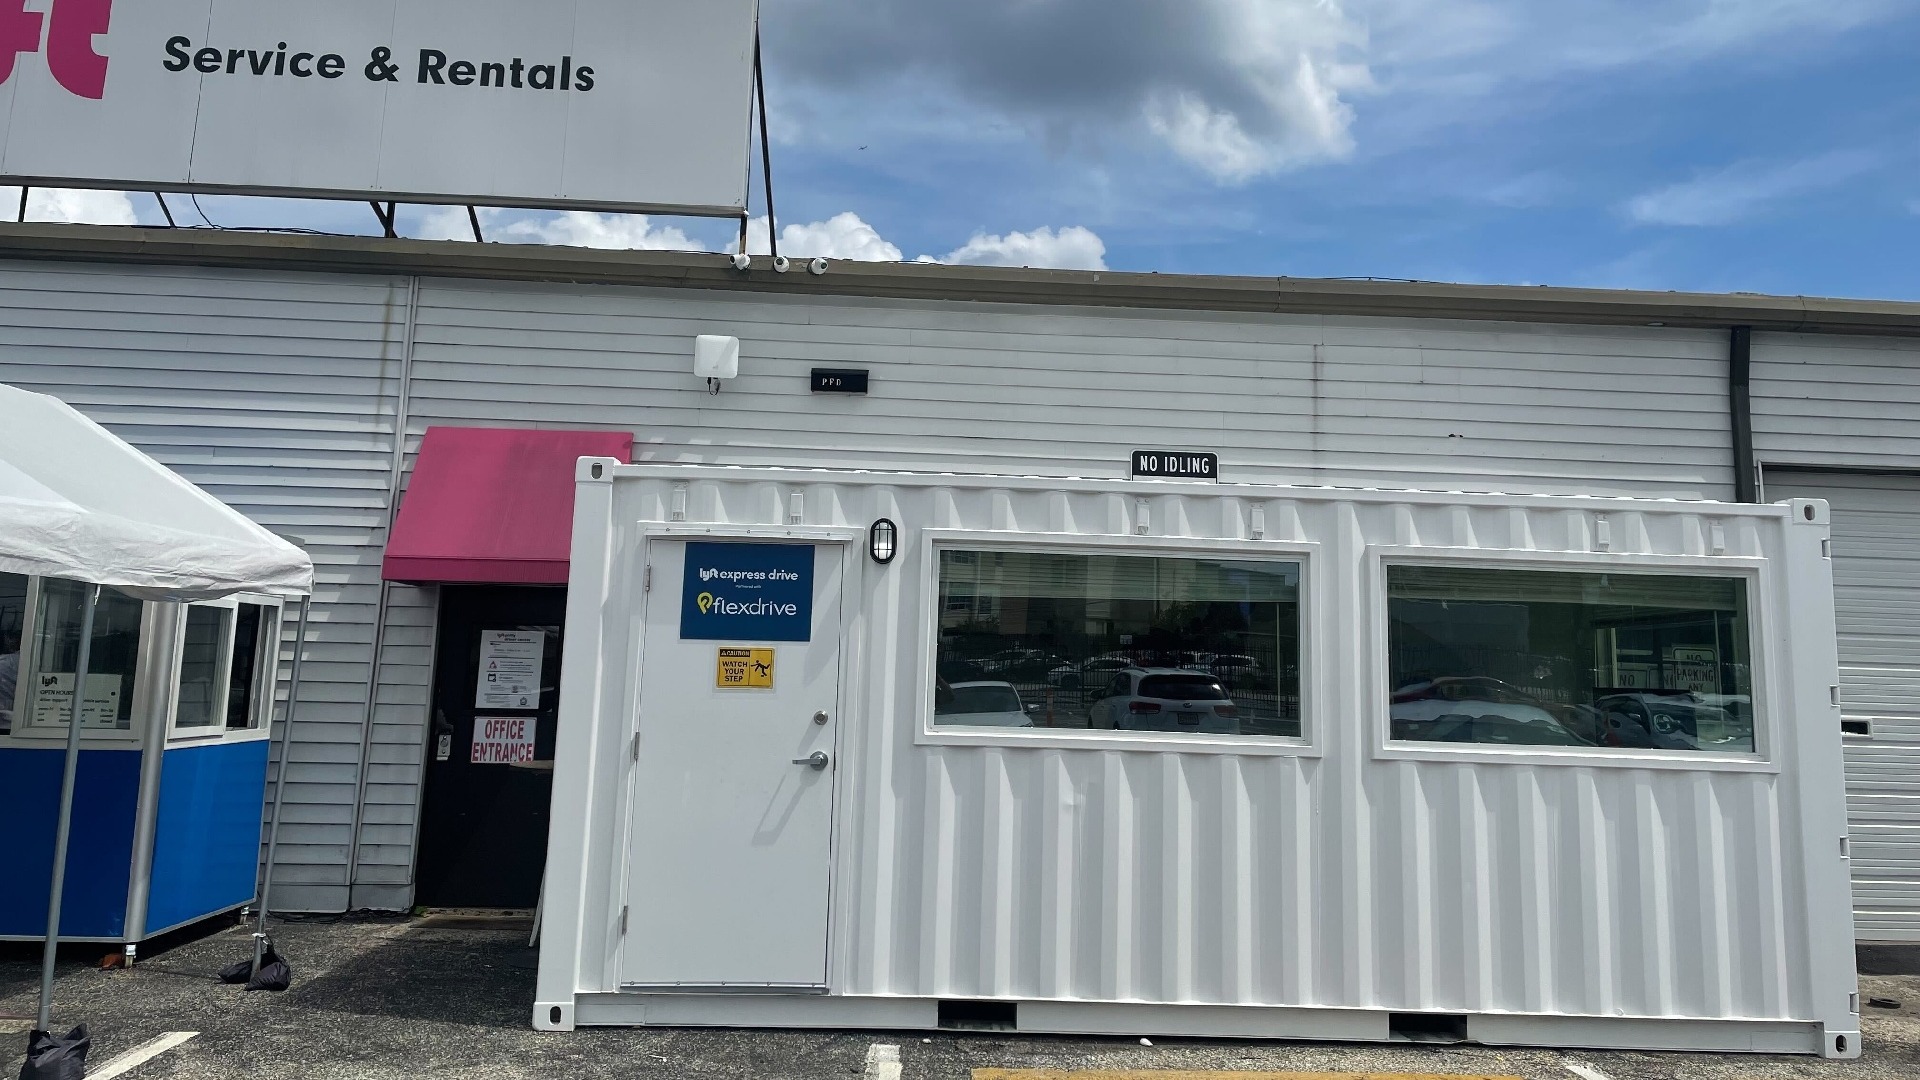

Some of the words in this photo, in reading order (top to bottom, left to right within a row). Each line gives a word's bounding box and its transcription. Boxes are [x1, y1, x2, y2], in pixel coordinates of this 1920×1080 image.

[162, 35, 346, 79] Service
[364, 45, 399, 82] &
[417, 48, 596, 92] Rentals
[1140, 455, 1158, 472] NO
[1164, 456, 1210, 474] IDLING
[699, 567, 719, 582] lyft
[719, 571, 766, 583] express
[768, 568, 799, 581] drive
[713, 597, 796, 616] flexdrive
[1619, 674, 1635, 687] NO
[1676, 668, 1714, 682] PARKING
[485, 720, 524, 740] OFFICE
[472, 742, 533, 762] ENTRANCE
